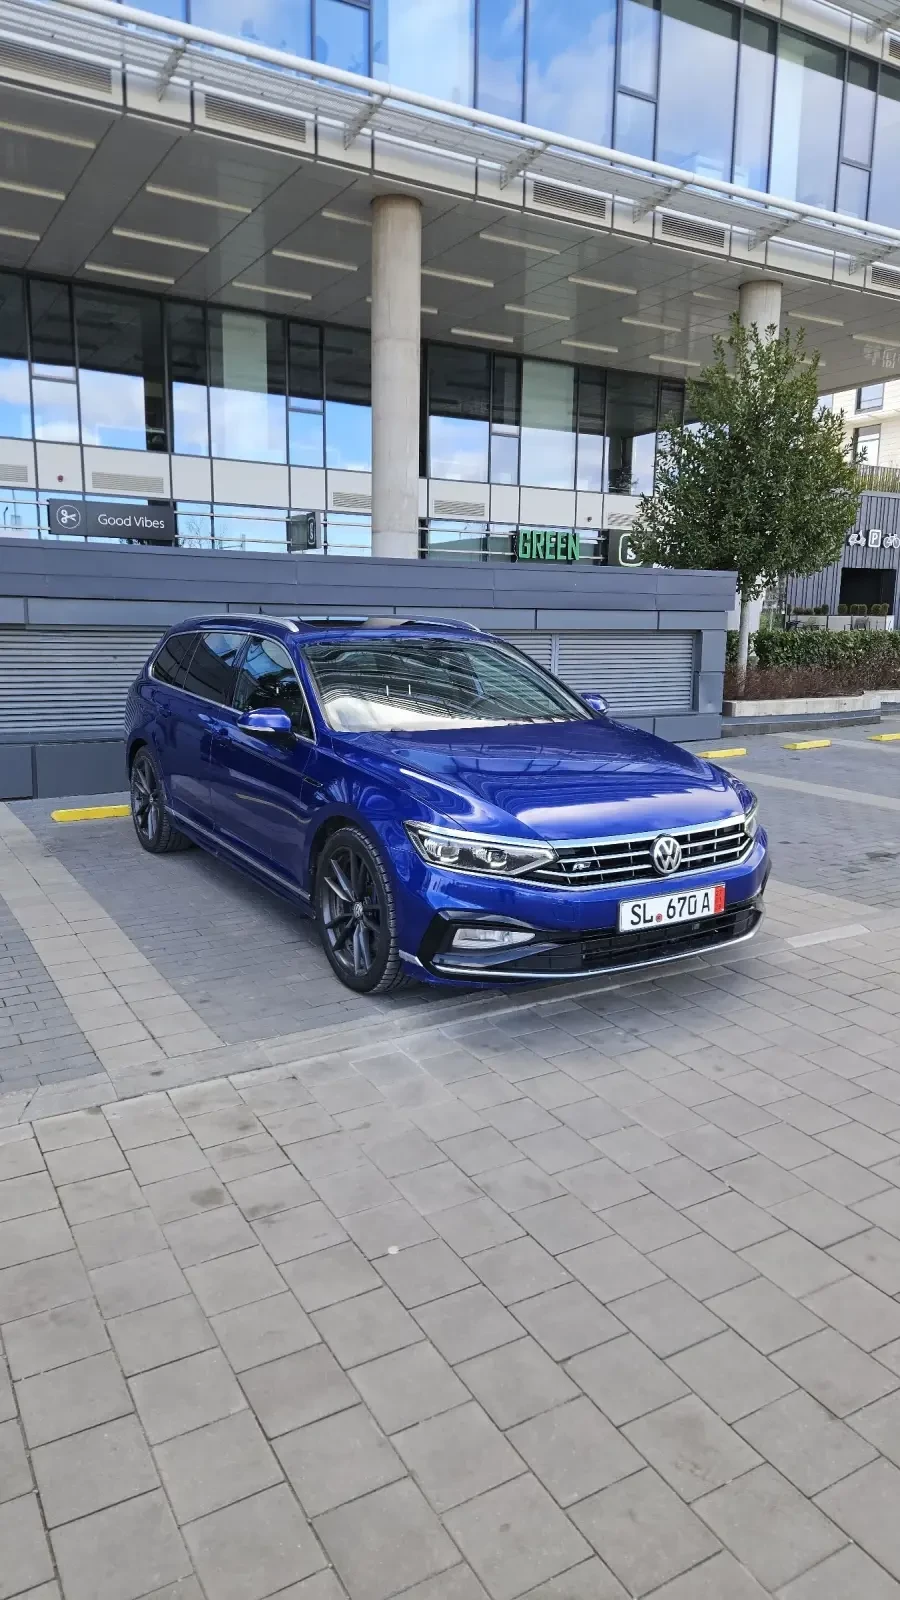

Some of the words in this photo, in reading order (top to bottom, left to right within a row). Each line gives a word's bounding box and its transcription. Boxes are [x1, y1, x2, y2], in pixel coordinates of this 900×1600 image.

[97, 513, 132, 527] Good
[134, 516, 165, 529] Vibes
[519, 529, 580, 561] GREEN
[630, 903, 654, 926] SL
[666, 894, 698, 920] 670
[701, 892, 711, 914] A
